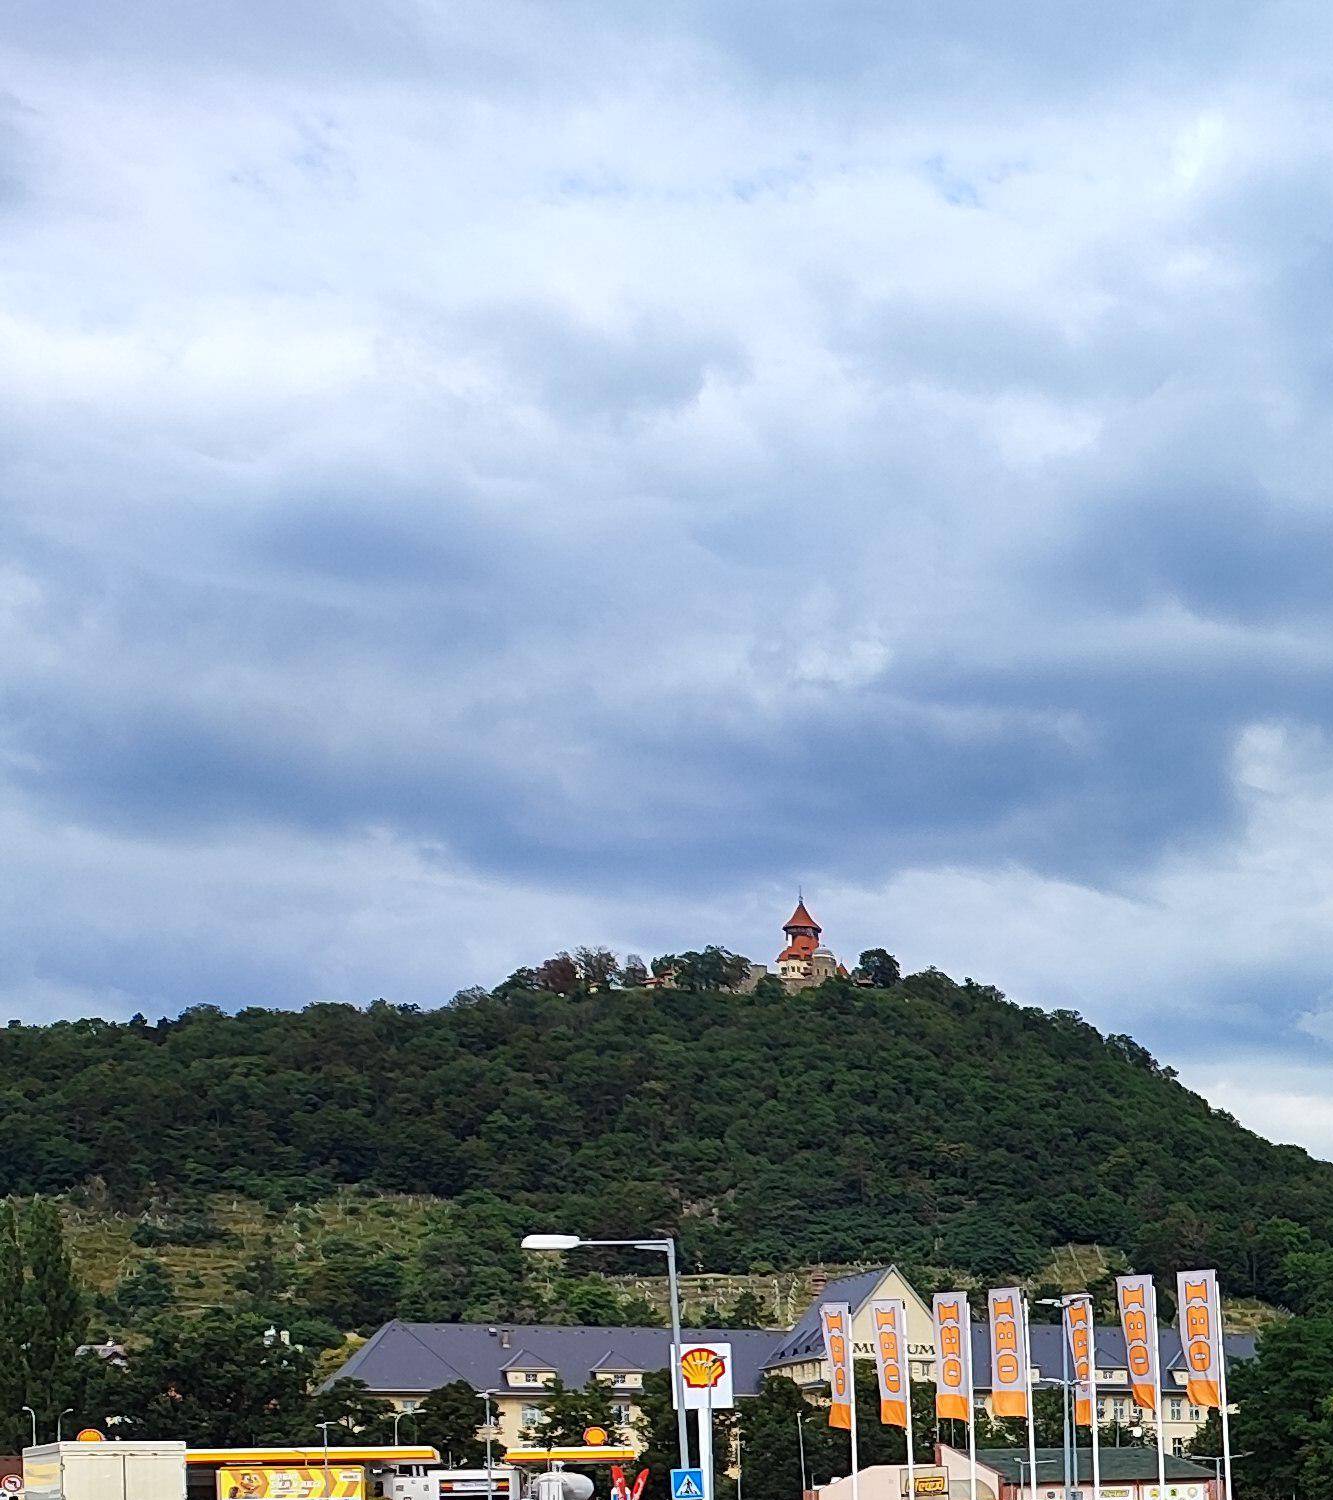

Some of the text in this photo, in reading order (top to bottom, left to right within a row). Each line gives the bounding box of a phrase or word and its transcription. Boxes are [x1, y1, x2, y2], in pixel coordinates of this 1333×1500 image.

[937, 1301, 962, 1387] OBI
[992, 1295, 1019, 1384] OBI
[1122, 1284, 1149, 1376] OBI
[1184, 1279, 1211, 1372] OBI
